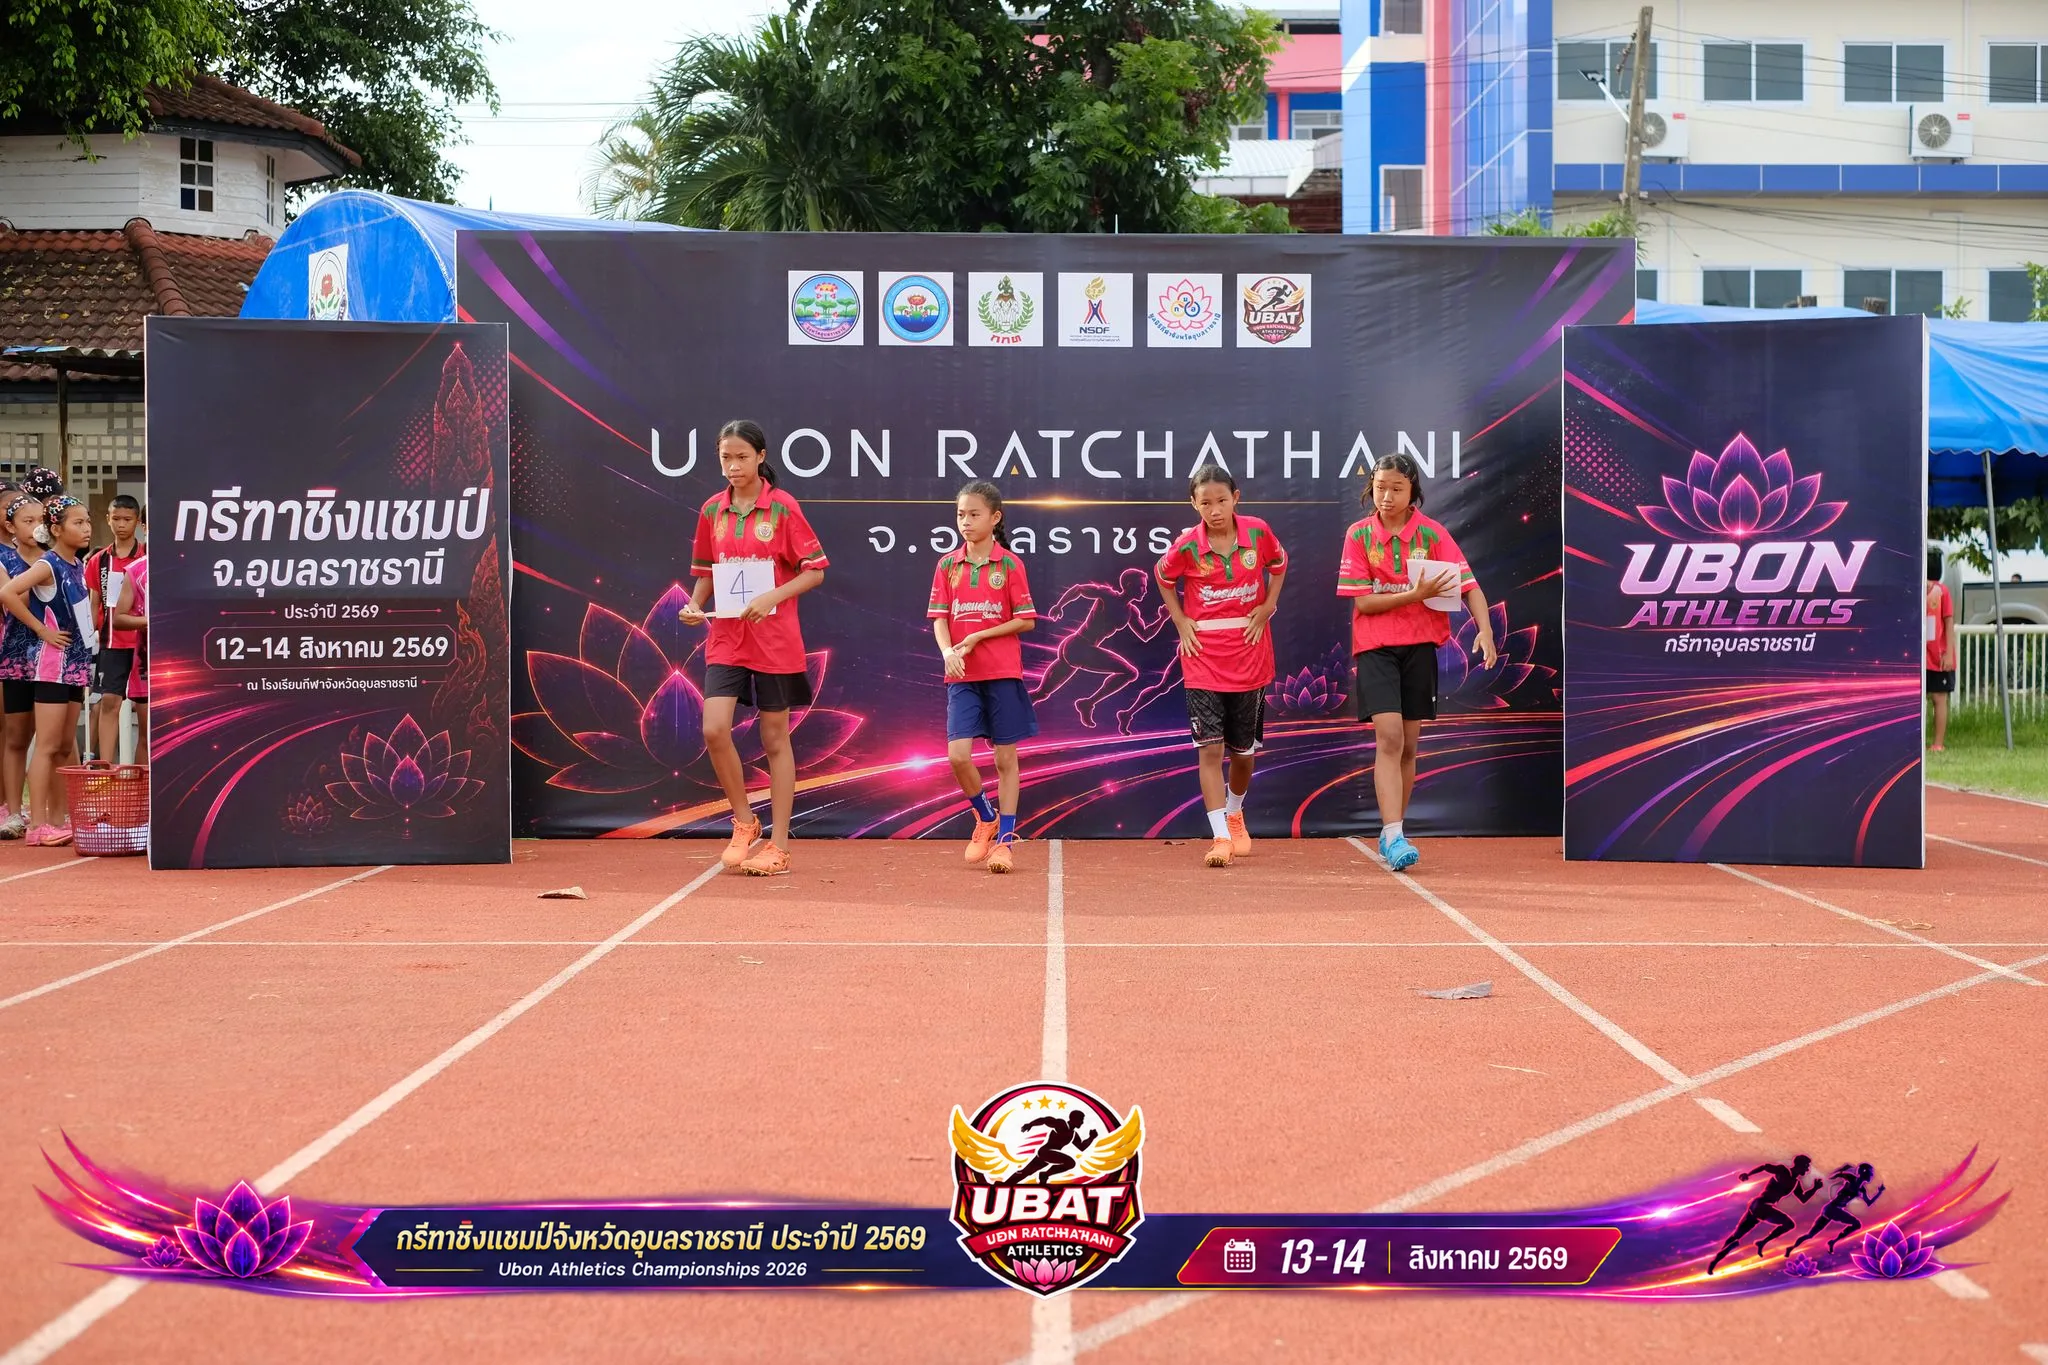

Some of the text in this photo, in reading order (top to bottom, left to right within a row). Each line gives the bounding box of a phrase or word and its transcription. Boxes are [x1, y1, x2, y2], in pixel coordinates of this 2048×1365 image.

[1079, 326, 1110, 334] NSDF
[1249, 311, 1300, 325] UBAT
[990, 334, 1022, 344] กกท
[651, 428, 1461, 479] UON RATCHATHANI
[174, 486, 490, 541] กรีฑาชิงแชมป์
[213, 547, 445, 598] จ.อุบลราชธานี
[1620, 540, 1877, 595] UBON
[730, 570, 753, 604] 4
[284, 604, 379, 619] ประจำปี 2569
[1624, 598, 1866, 629] ATHLETICS
[299, 636, 383, 659] สิงหาคม
[392, 636, 448, 658] 2569
[1664, 632, 1816, 658] กรีฑาอุบลราชธานี
[247, 676, 418, 693] ณ โรงเรียนกีฬาจังหวัดอุบลราชธานี
